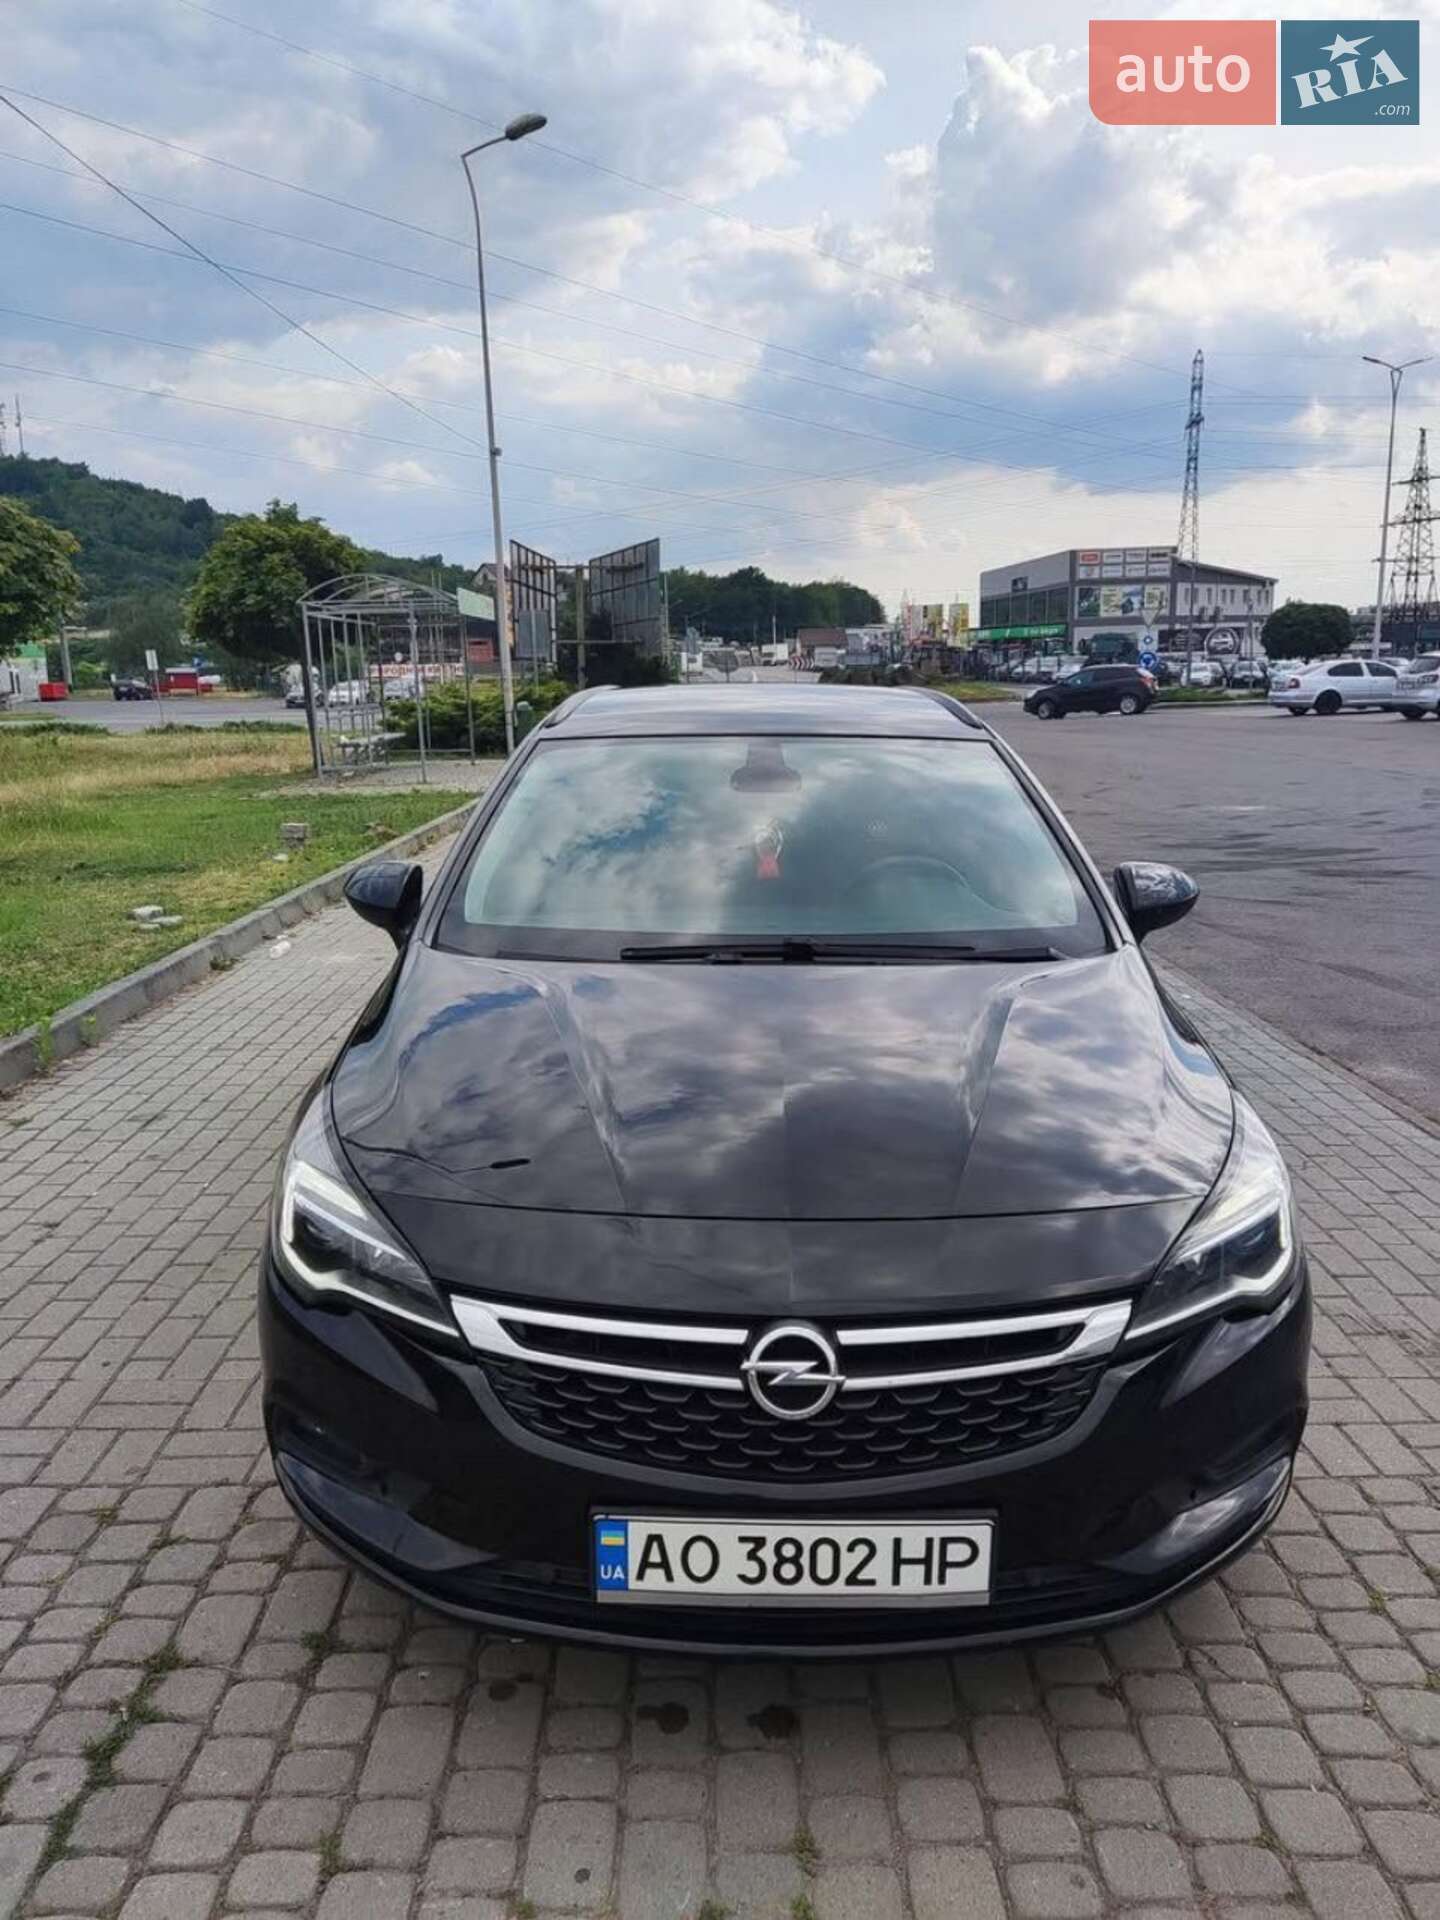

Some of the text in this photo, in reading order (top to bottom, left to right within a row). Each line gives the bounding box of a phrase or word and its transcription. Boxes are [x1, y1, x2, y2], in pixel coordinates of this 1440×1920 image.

[600, 1564, 625, 1581] UA
[635, 1533, 980, 1587] AO 3802 HP
